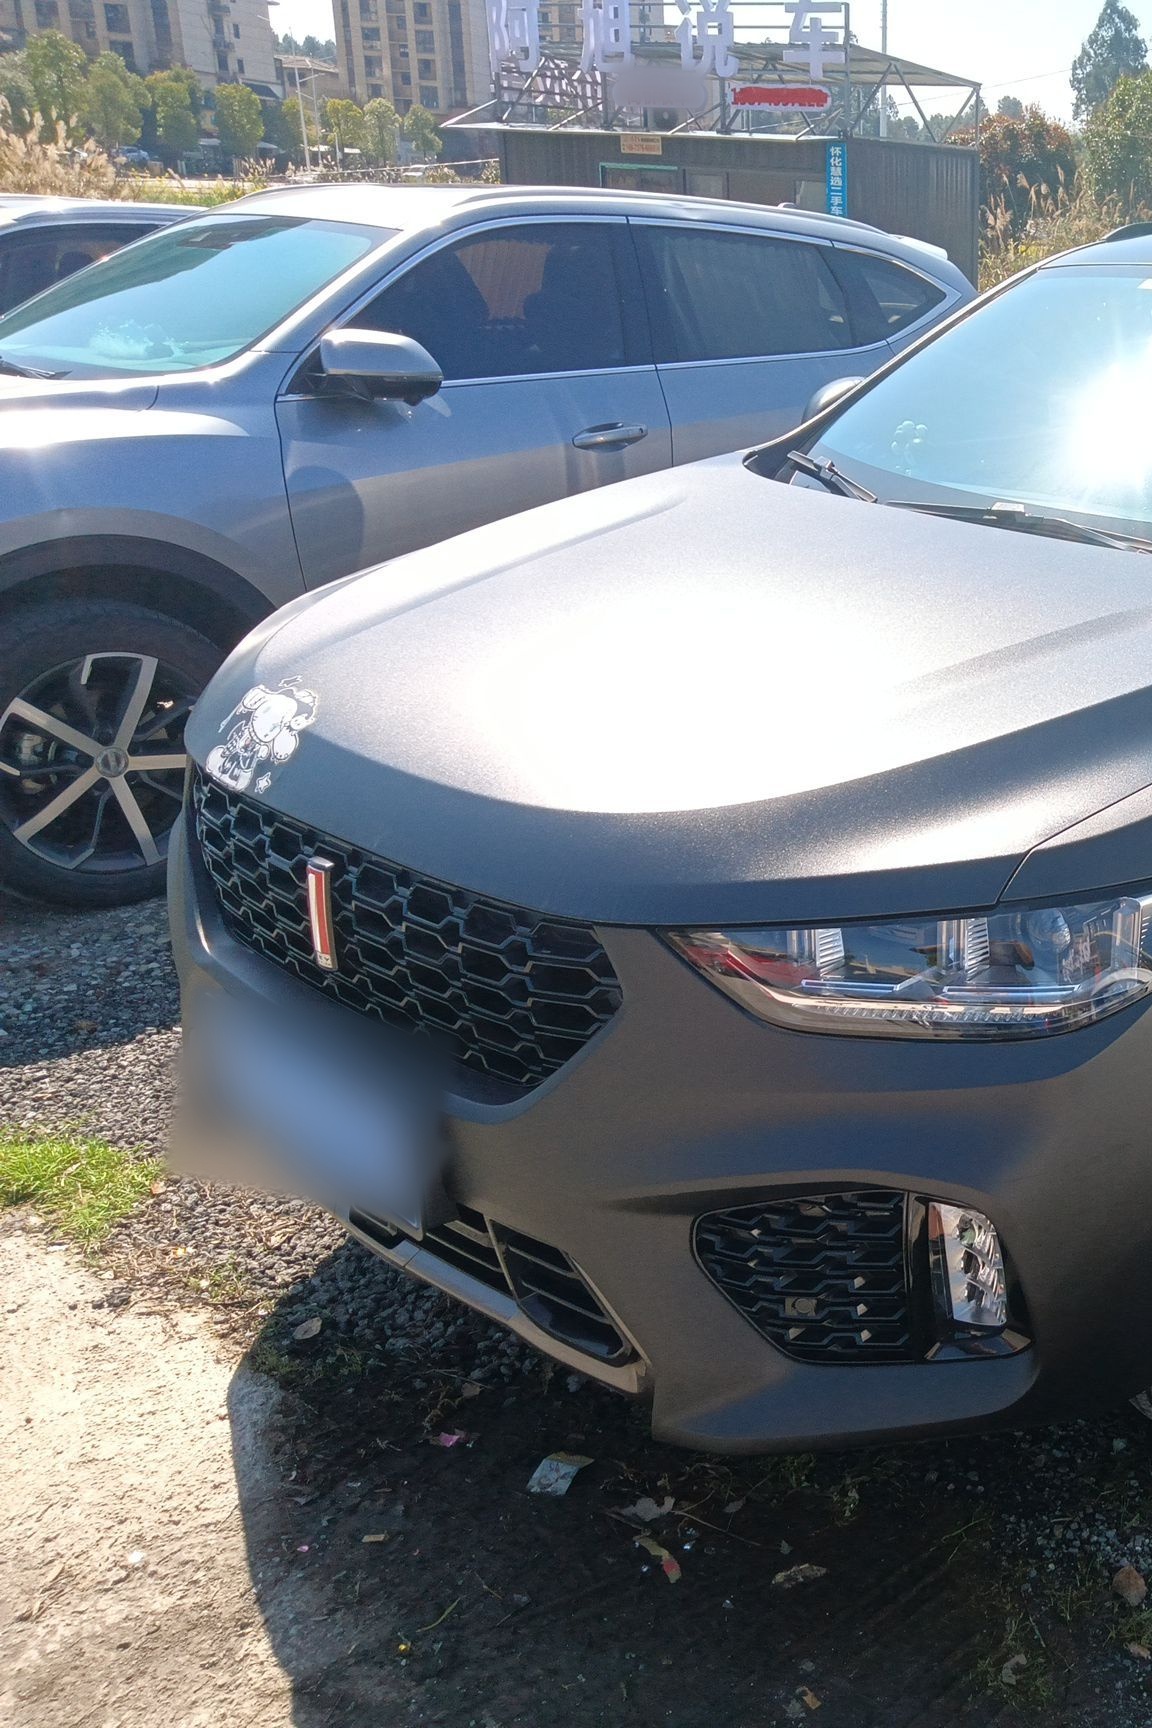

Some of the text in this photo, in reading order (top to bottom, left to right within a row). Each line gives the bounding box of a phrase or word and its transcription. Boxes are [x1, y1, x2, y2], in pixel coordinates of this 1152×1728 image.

[830, 145, 843, 216] 怀化慧选二手车
